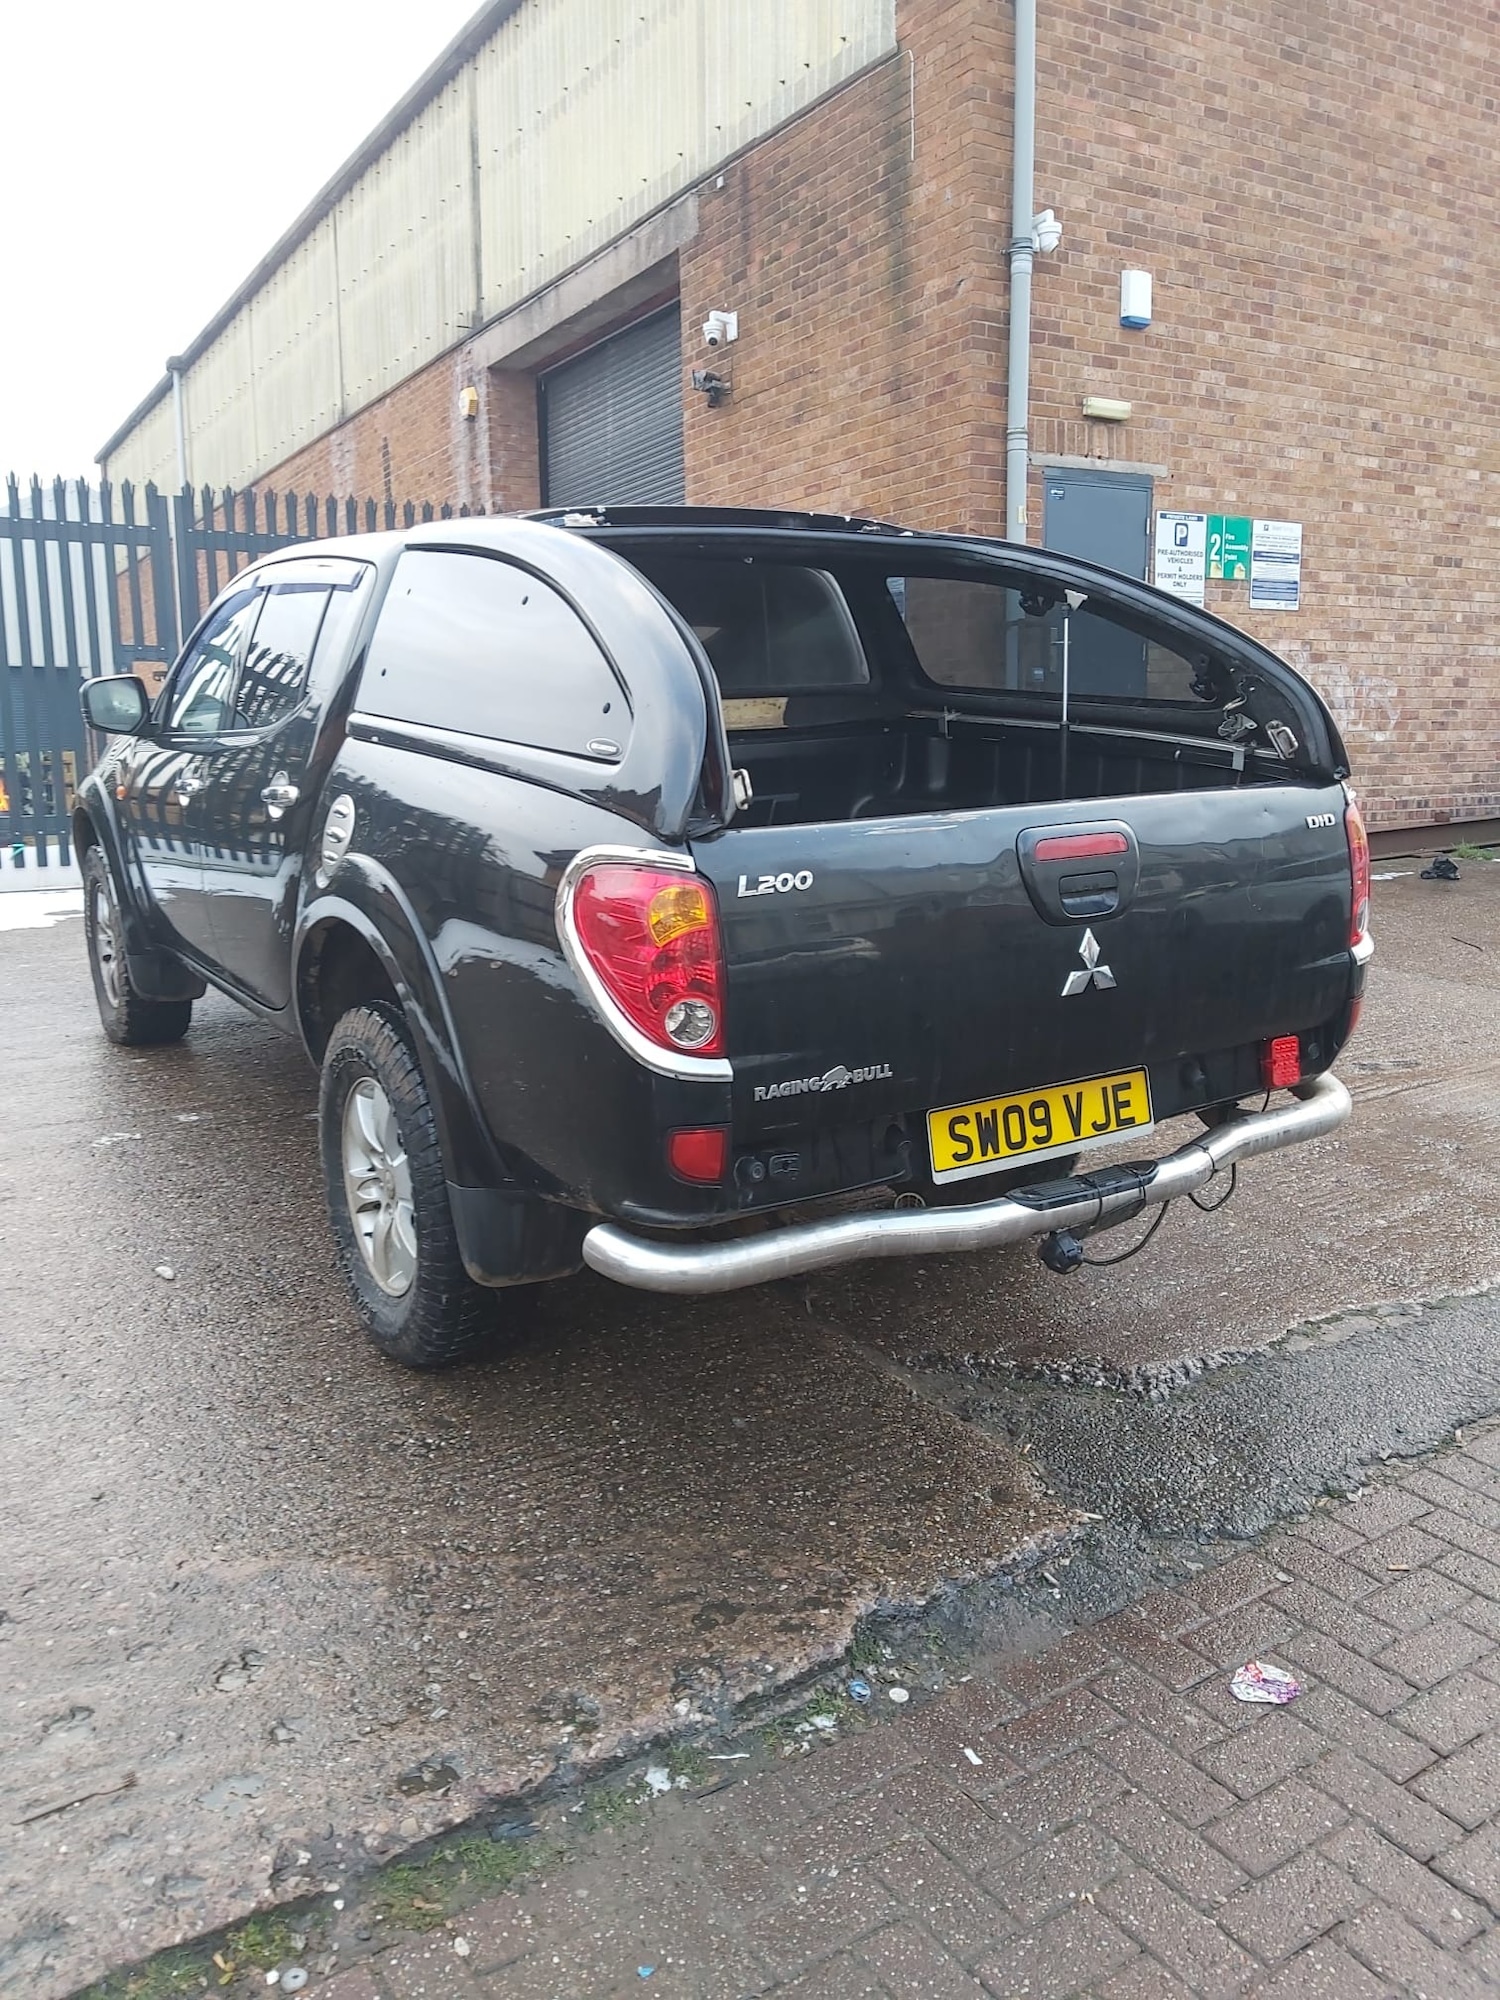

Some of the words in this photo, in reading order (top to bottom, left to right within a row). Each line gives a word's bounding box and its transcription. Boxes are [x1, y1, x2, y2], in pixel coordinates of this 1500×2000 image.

[1225, 533, 1236, 541] Fire
[1210, 533, 1221, 561] 2
[1225, 543, 1249, 553] Assembly
[1157, 549, 1204, 557] PRE-AUTHORISED
[1167, 557, 1194, 565] VEHICLES
[1157, 572, 1177, 580] PERMIT
[1178, 573, 1203, 581] HOLDERS
[737, 870, 814, 898] L200
[754, 1076, 822, 1101] RAGING
[852, 1063, 893, 1084] BULL
[948, 1099, 1053, 1162] SW09
[1062, 1081, 1136, 1137] VJE
